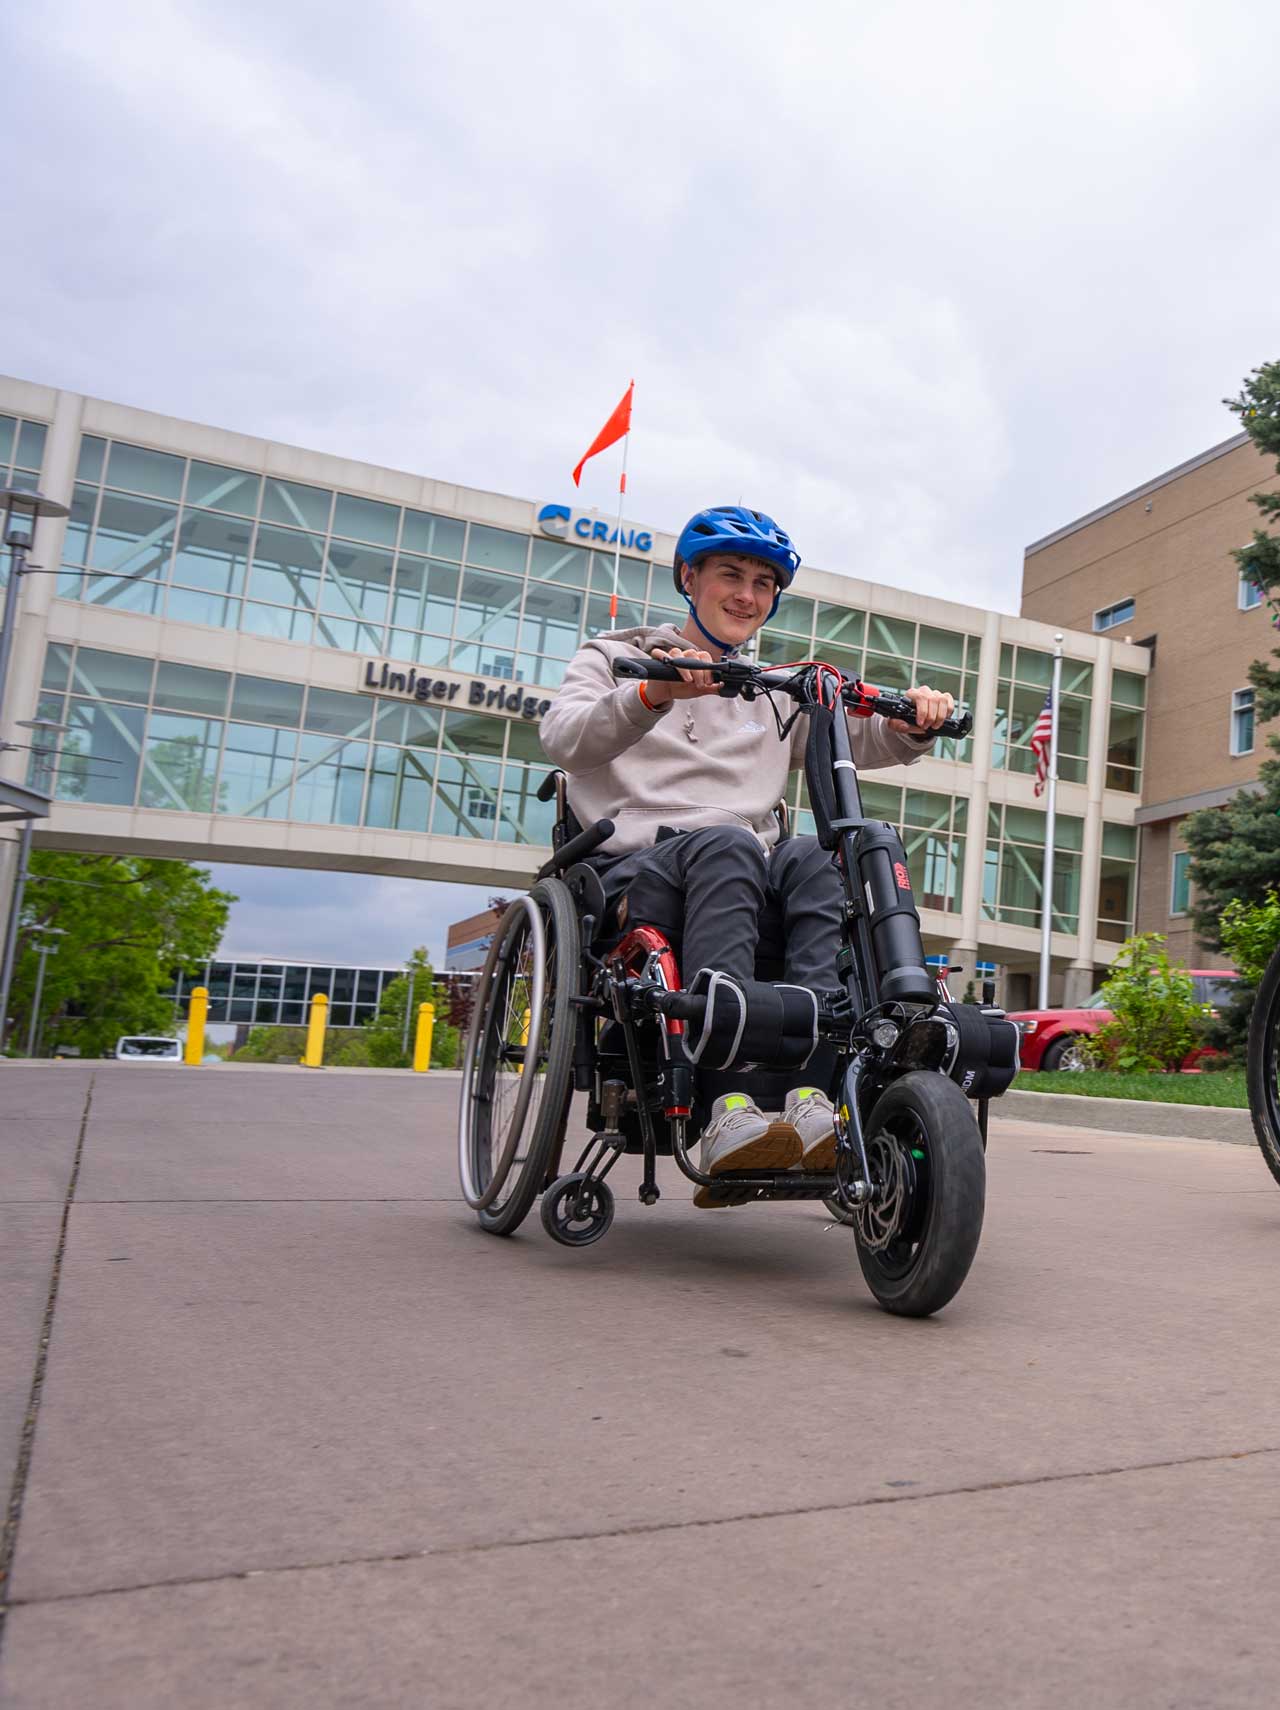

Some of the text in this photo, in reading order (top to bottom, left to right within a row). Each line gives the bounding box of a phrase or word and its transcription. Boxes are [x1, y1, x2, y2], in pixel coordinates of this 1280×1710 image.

[575, 518, 652, 552] CRAIG
[366, 661, 552, 720] Liniger Bridge
